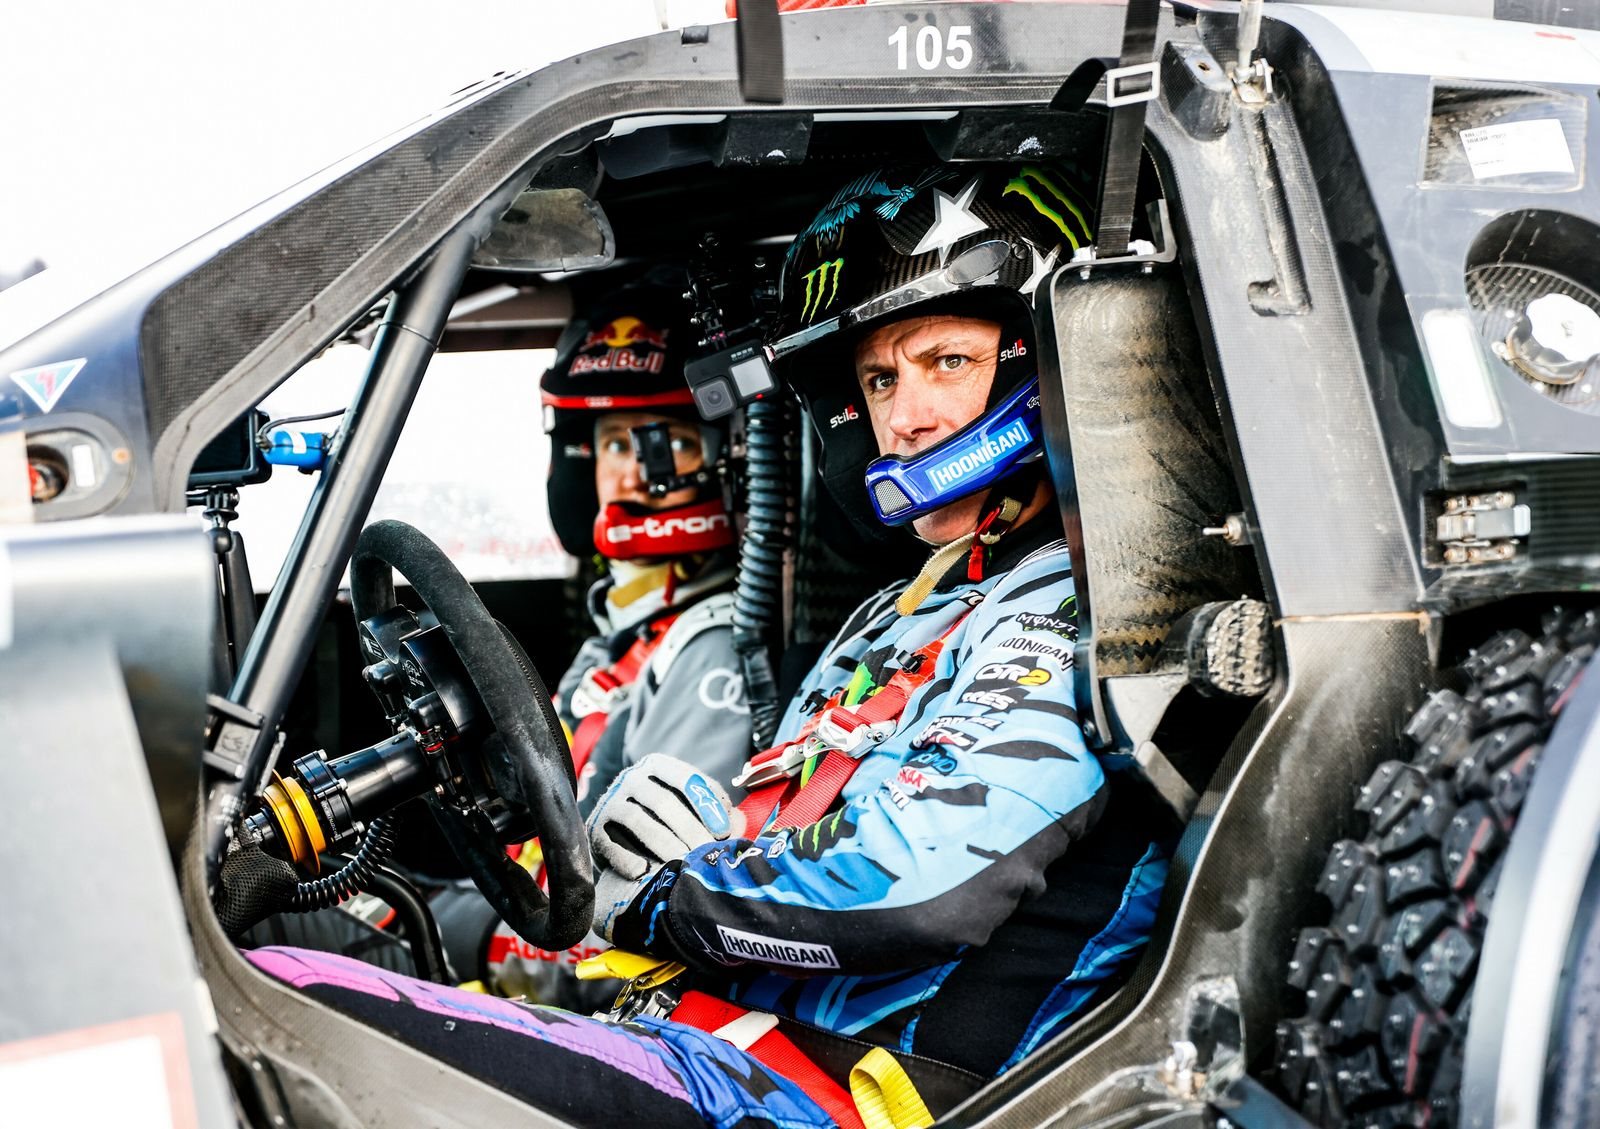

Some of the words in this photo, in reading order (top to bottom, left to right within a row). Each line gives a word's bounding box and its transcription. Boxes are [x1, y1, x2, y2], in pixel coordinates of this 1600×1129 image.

[888, 25, 973, 70] 105
[568, 352, 612, 376] Red
[613, 350, 664, 374] Bull
[606, 513, 729, 543] e-tron
[1017, 613, 1079, 633] MONST
